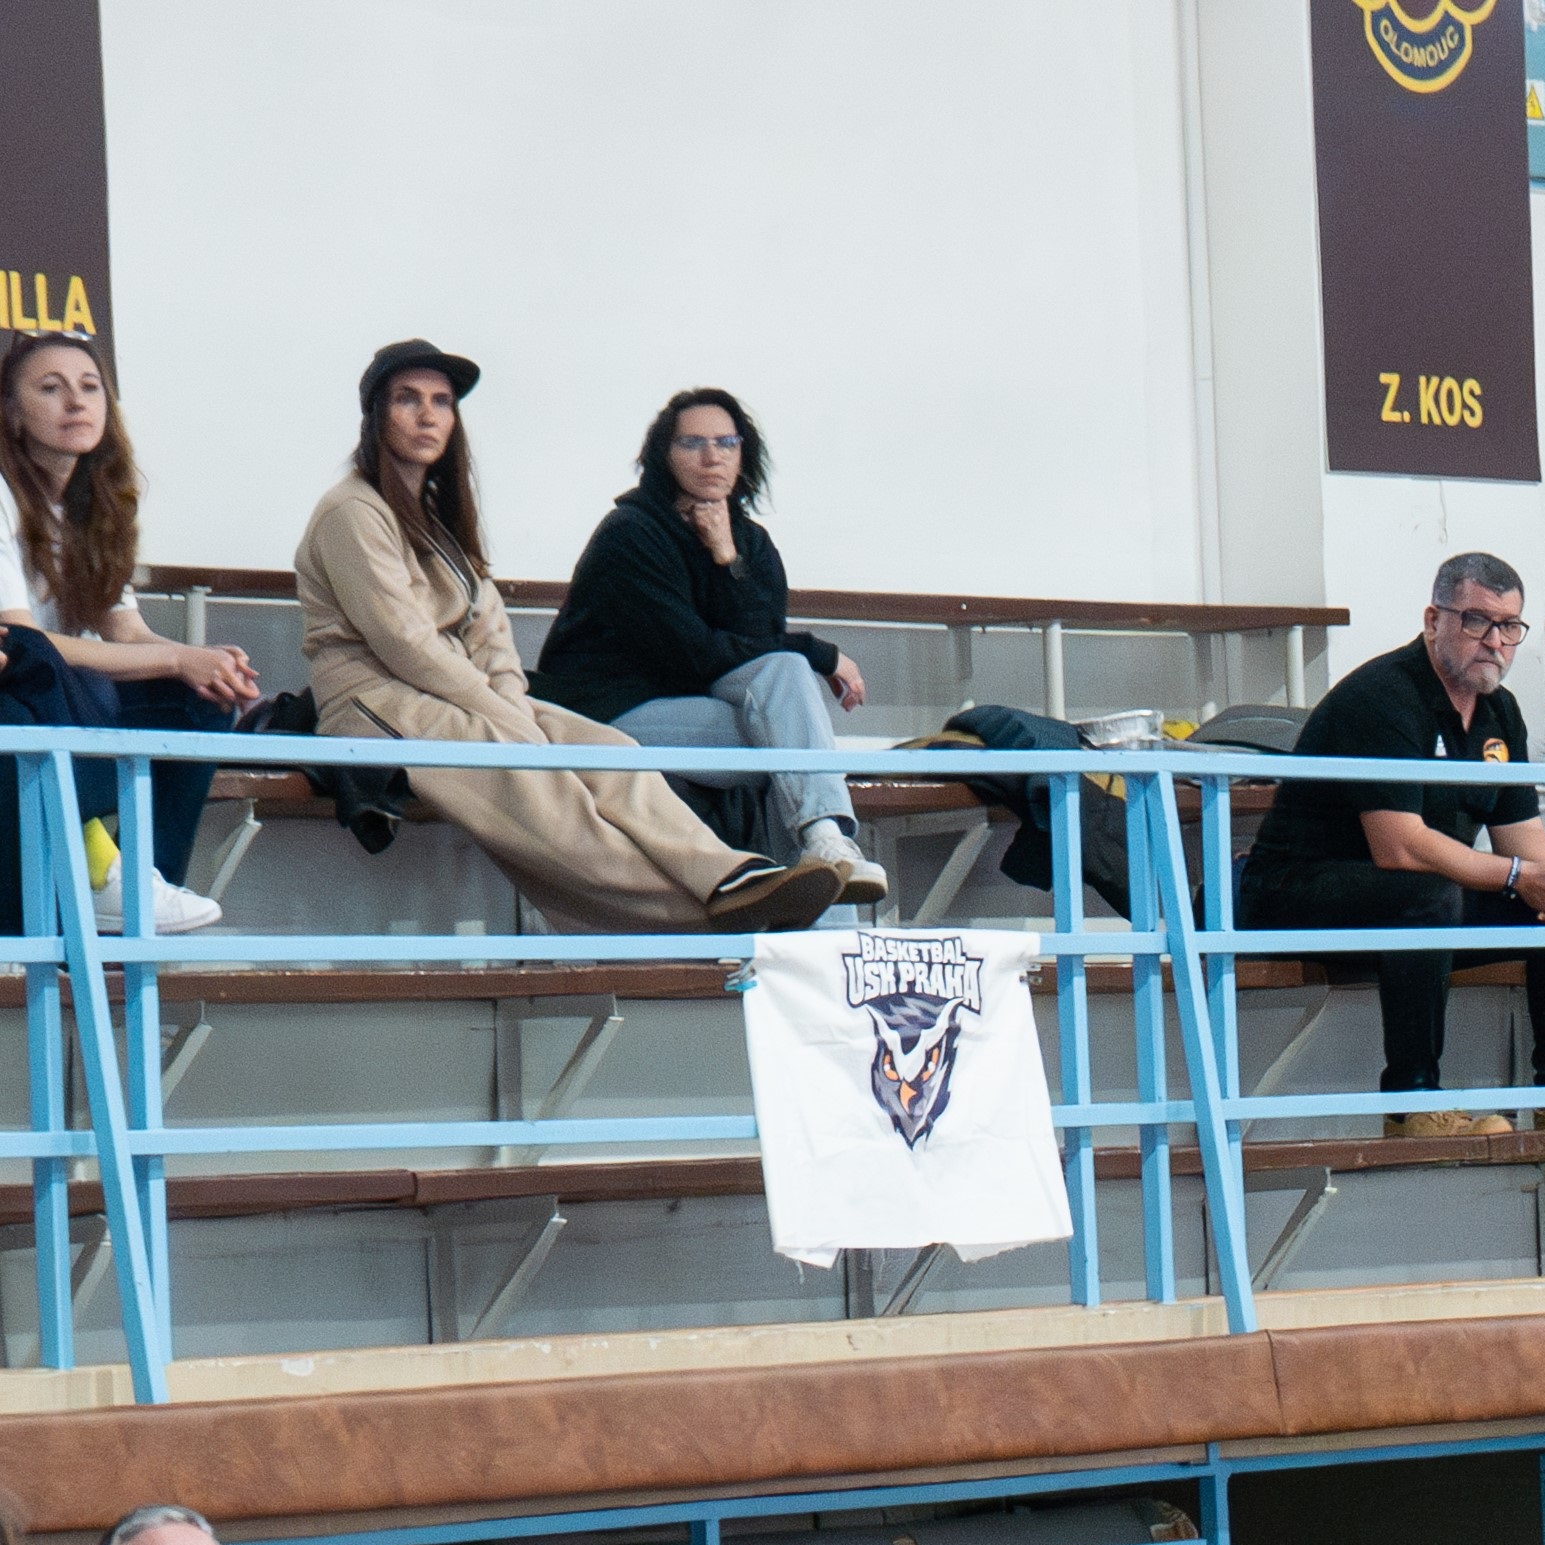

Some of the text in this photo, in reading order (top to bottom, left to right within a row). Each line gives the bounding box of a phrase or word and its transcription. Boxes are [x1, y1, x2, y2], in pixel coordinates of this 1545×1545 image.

[1380, 18, 1460, 68] OLOMOUC
[1379, 372, 1484, 429] Z. KOS
[859, 933, 966, 965] BASKETBAL
[844, 955, 982, 1012] USK PRAHA
